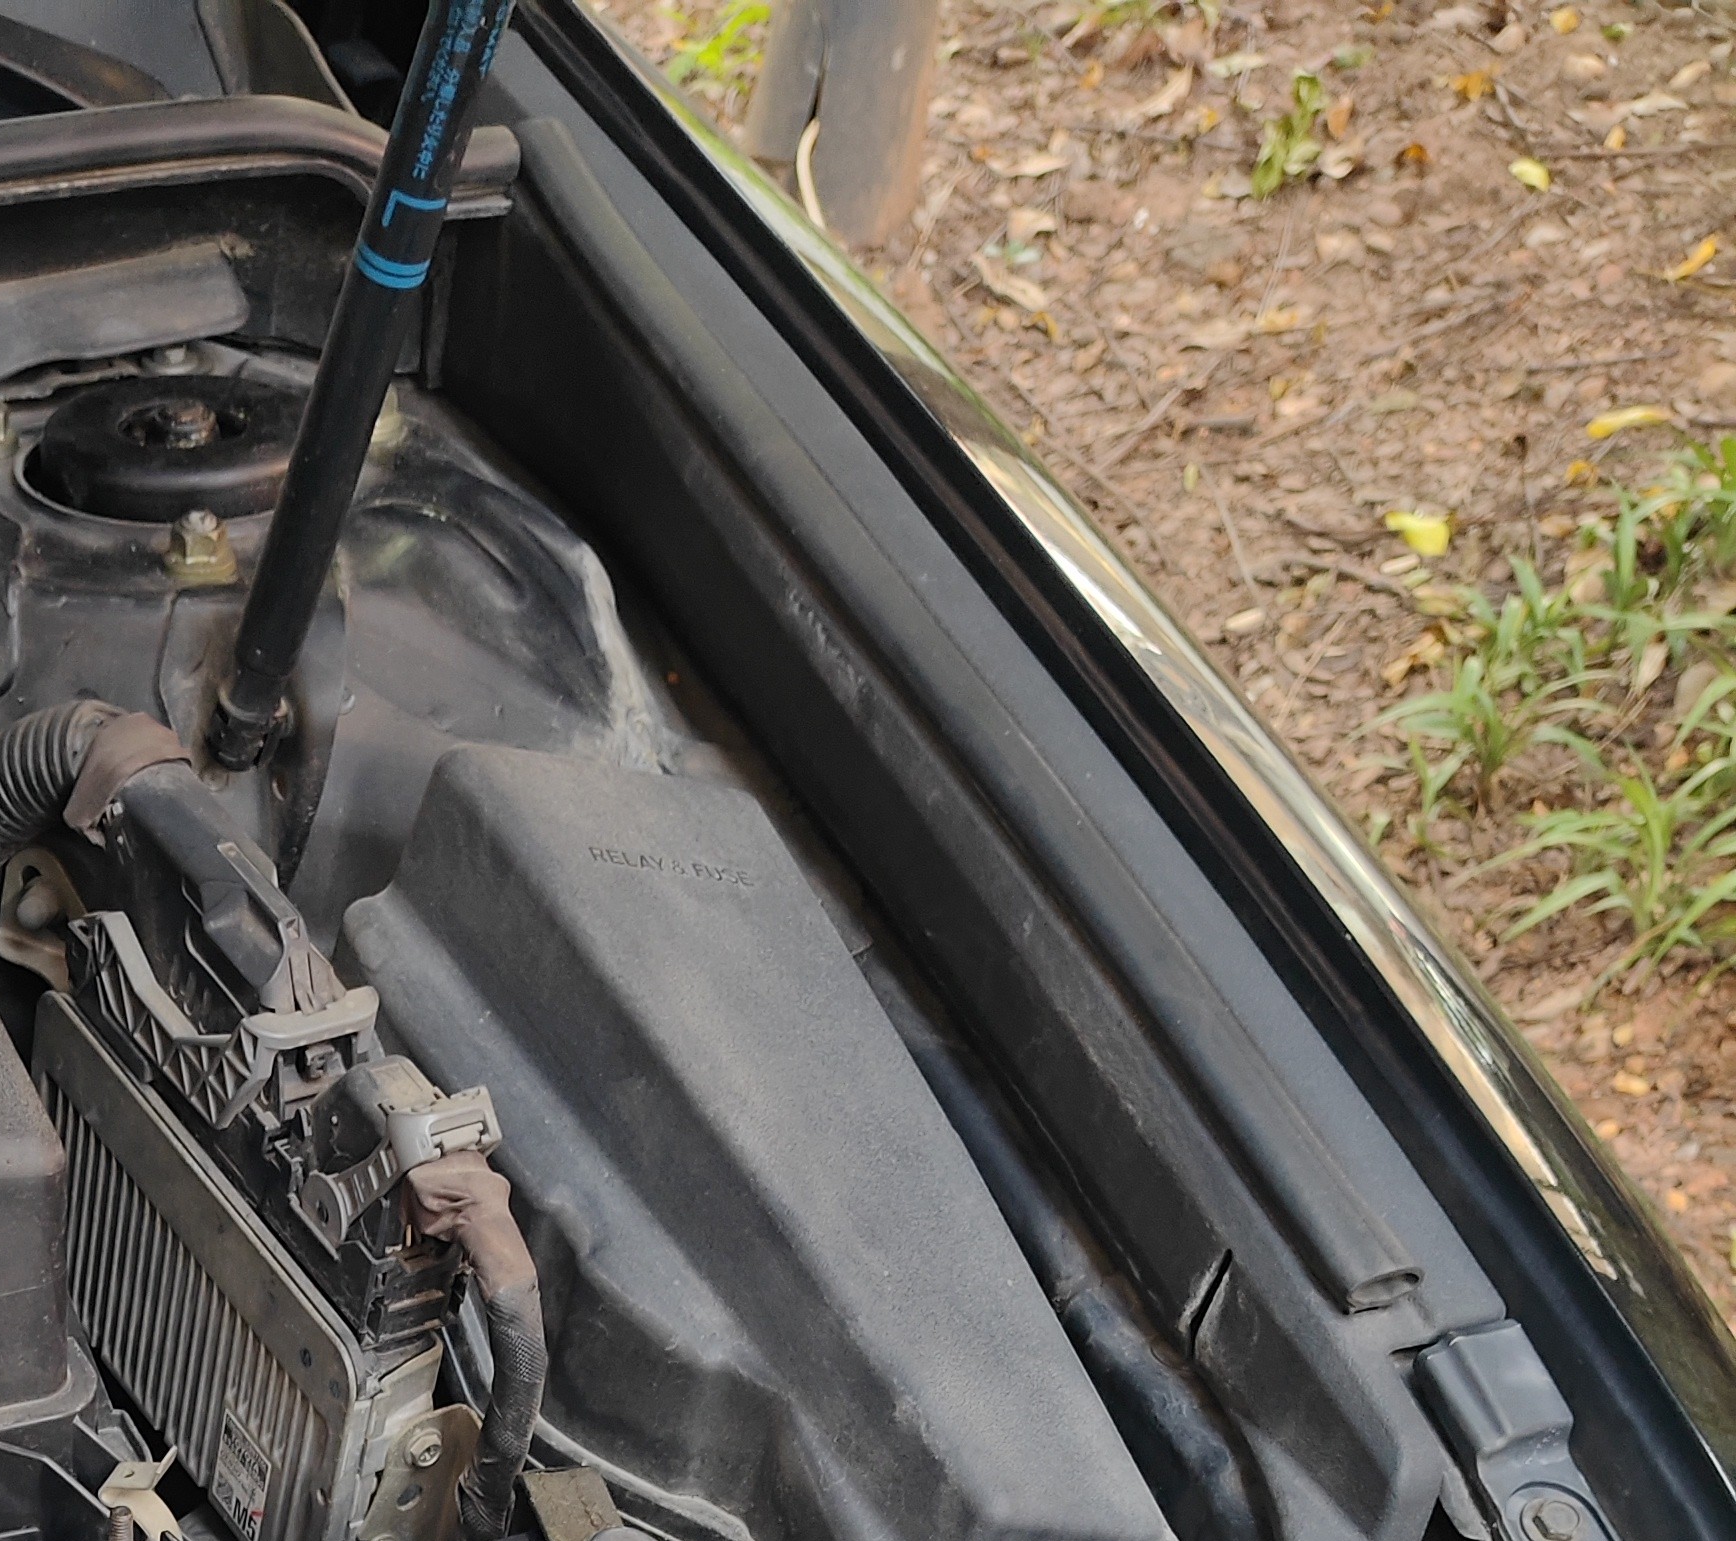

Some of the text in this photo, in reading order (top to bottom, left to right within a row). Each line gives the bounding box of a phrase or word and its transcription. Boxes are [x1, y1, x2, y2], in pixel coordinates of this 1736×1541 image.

[588, 846, 755, 888] RELAY & FUSE
